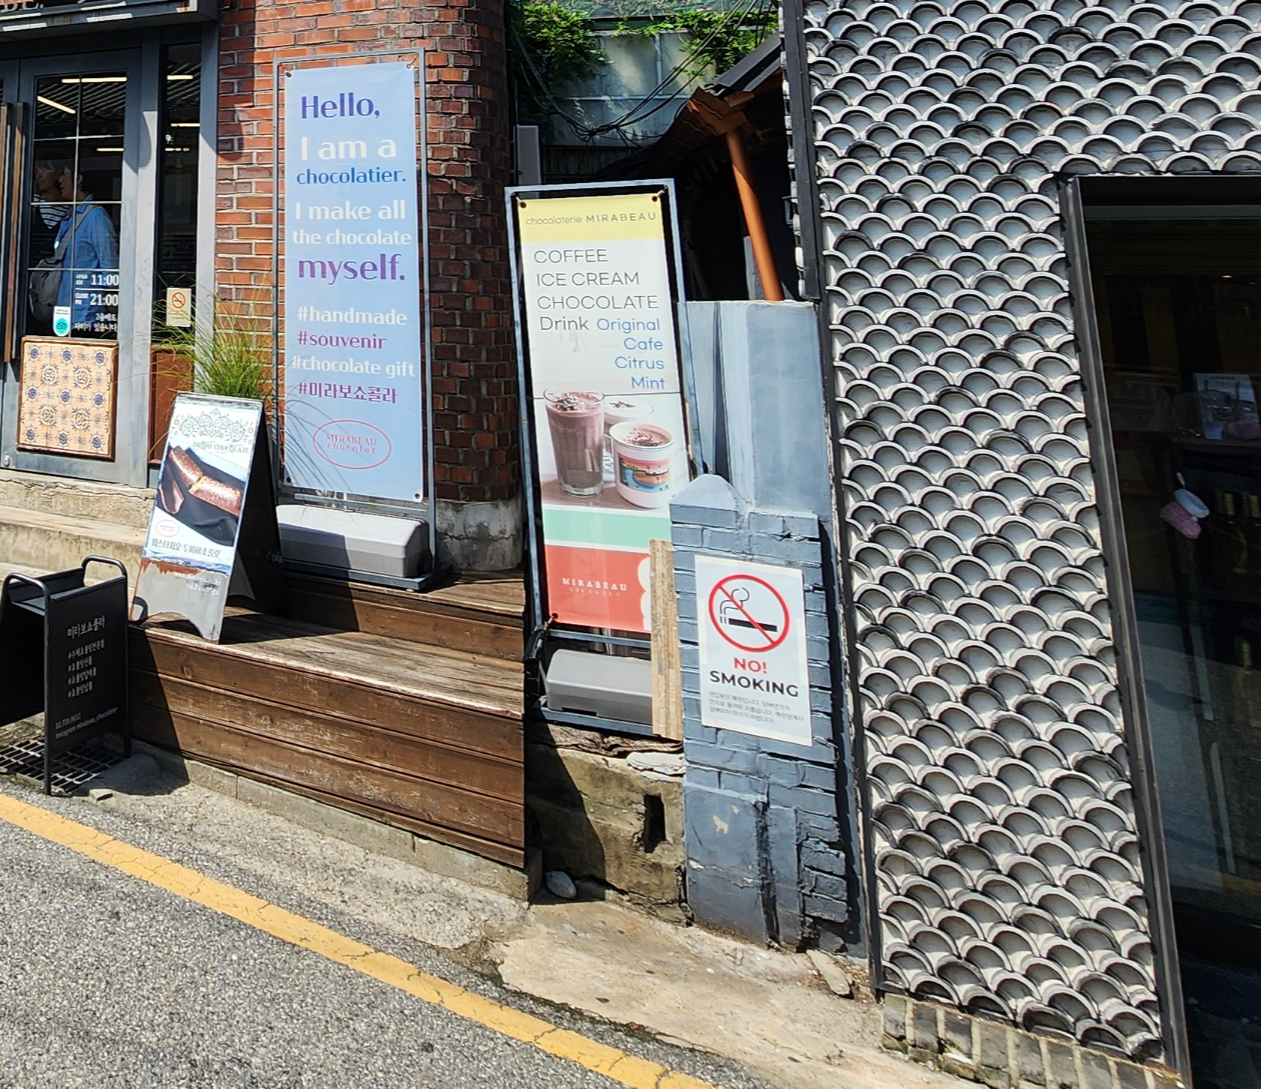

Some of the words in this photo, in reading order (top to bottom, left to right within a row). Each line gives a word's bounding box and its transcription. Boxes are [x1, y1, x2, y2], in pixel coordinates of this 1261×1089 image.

[301, 92, 380, 119] Hello,
[301, 137, 308, 160] I
[318, 140, 367, 160] am
[377, 139, 397, 158] a
[296, 167, 406, 184] chocolatier.
[295, 202, 301, 220] I
[308, 201, 371, 220] make
[378, 200, 406, 219] all
[526, 215, 582, 225] chocolaterie
[586, 212, 656, 222] MIRABEAU
[292, 229, 321, 245] the
[326, 229, 412, 245] chocolate
[533, 249, 608, 264] COFFEE
[298, 253, 405, 286] myself.
[91, 274, 119, 286] 11:00
[536, 273, 567, 287] ICE
[571, 272, 640, 286] CREAM
[90, 294, 119, 306] 21:00
[537, 295, 659, 310] CHOCOLATE
[297, 306, 408, 326] #handmade
[540, 316, 589, 331] Drink
[596, 318, 661, 334] Original
[297, 331, 387, 349] #souvenir
[623, 337, 664, 351] Cafe
[291, 355, 381, 375] #chocolate
[385, 361, 416, 379] gift
[615, 356, 665, 370] Citrus
[631, 376, 666, 390] Mint
[297, 382, 397, 404] #미라보쇼콜라
[326, 434, 377, 446] MIRABEAU
[327, 443, 376, 454] chocolat
[562, 578, 628, 591] MIRABEAU
[68, 615, 105, 639] 미라보쇼콜라
[734, 657, 767, 674] NO!
[710, 670, 799, 697] SMOKING
